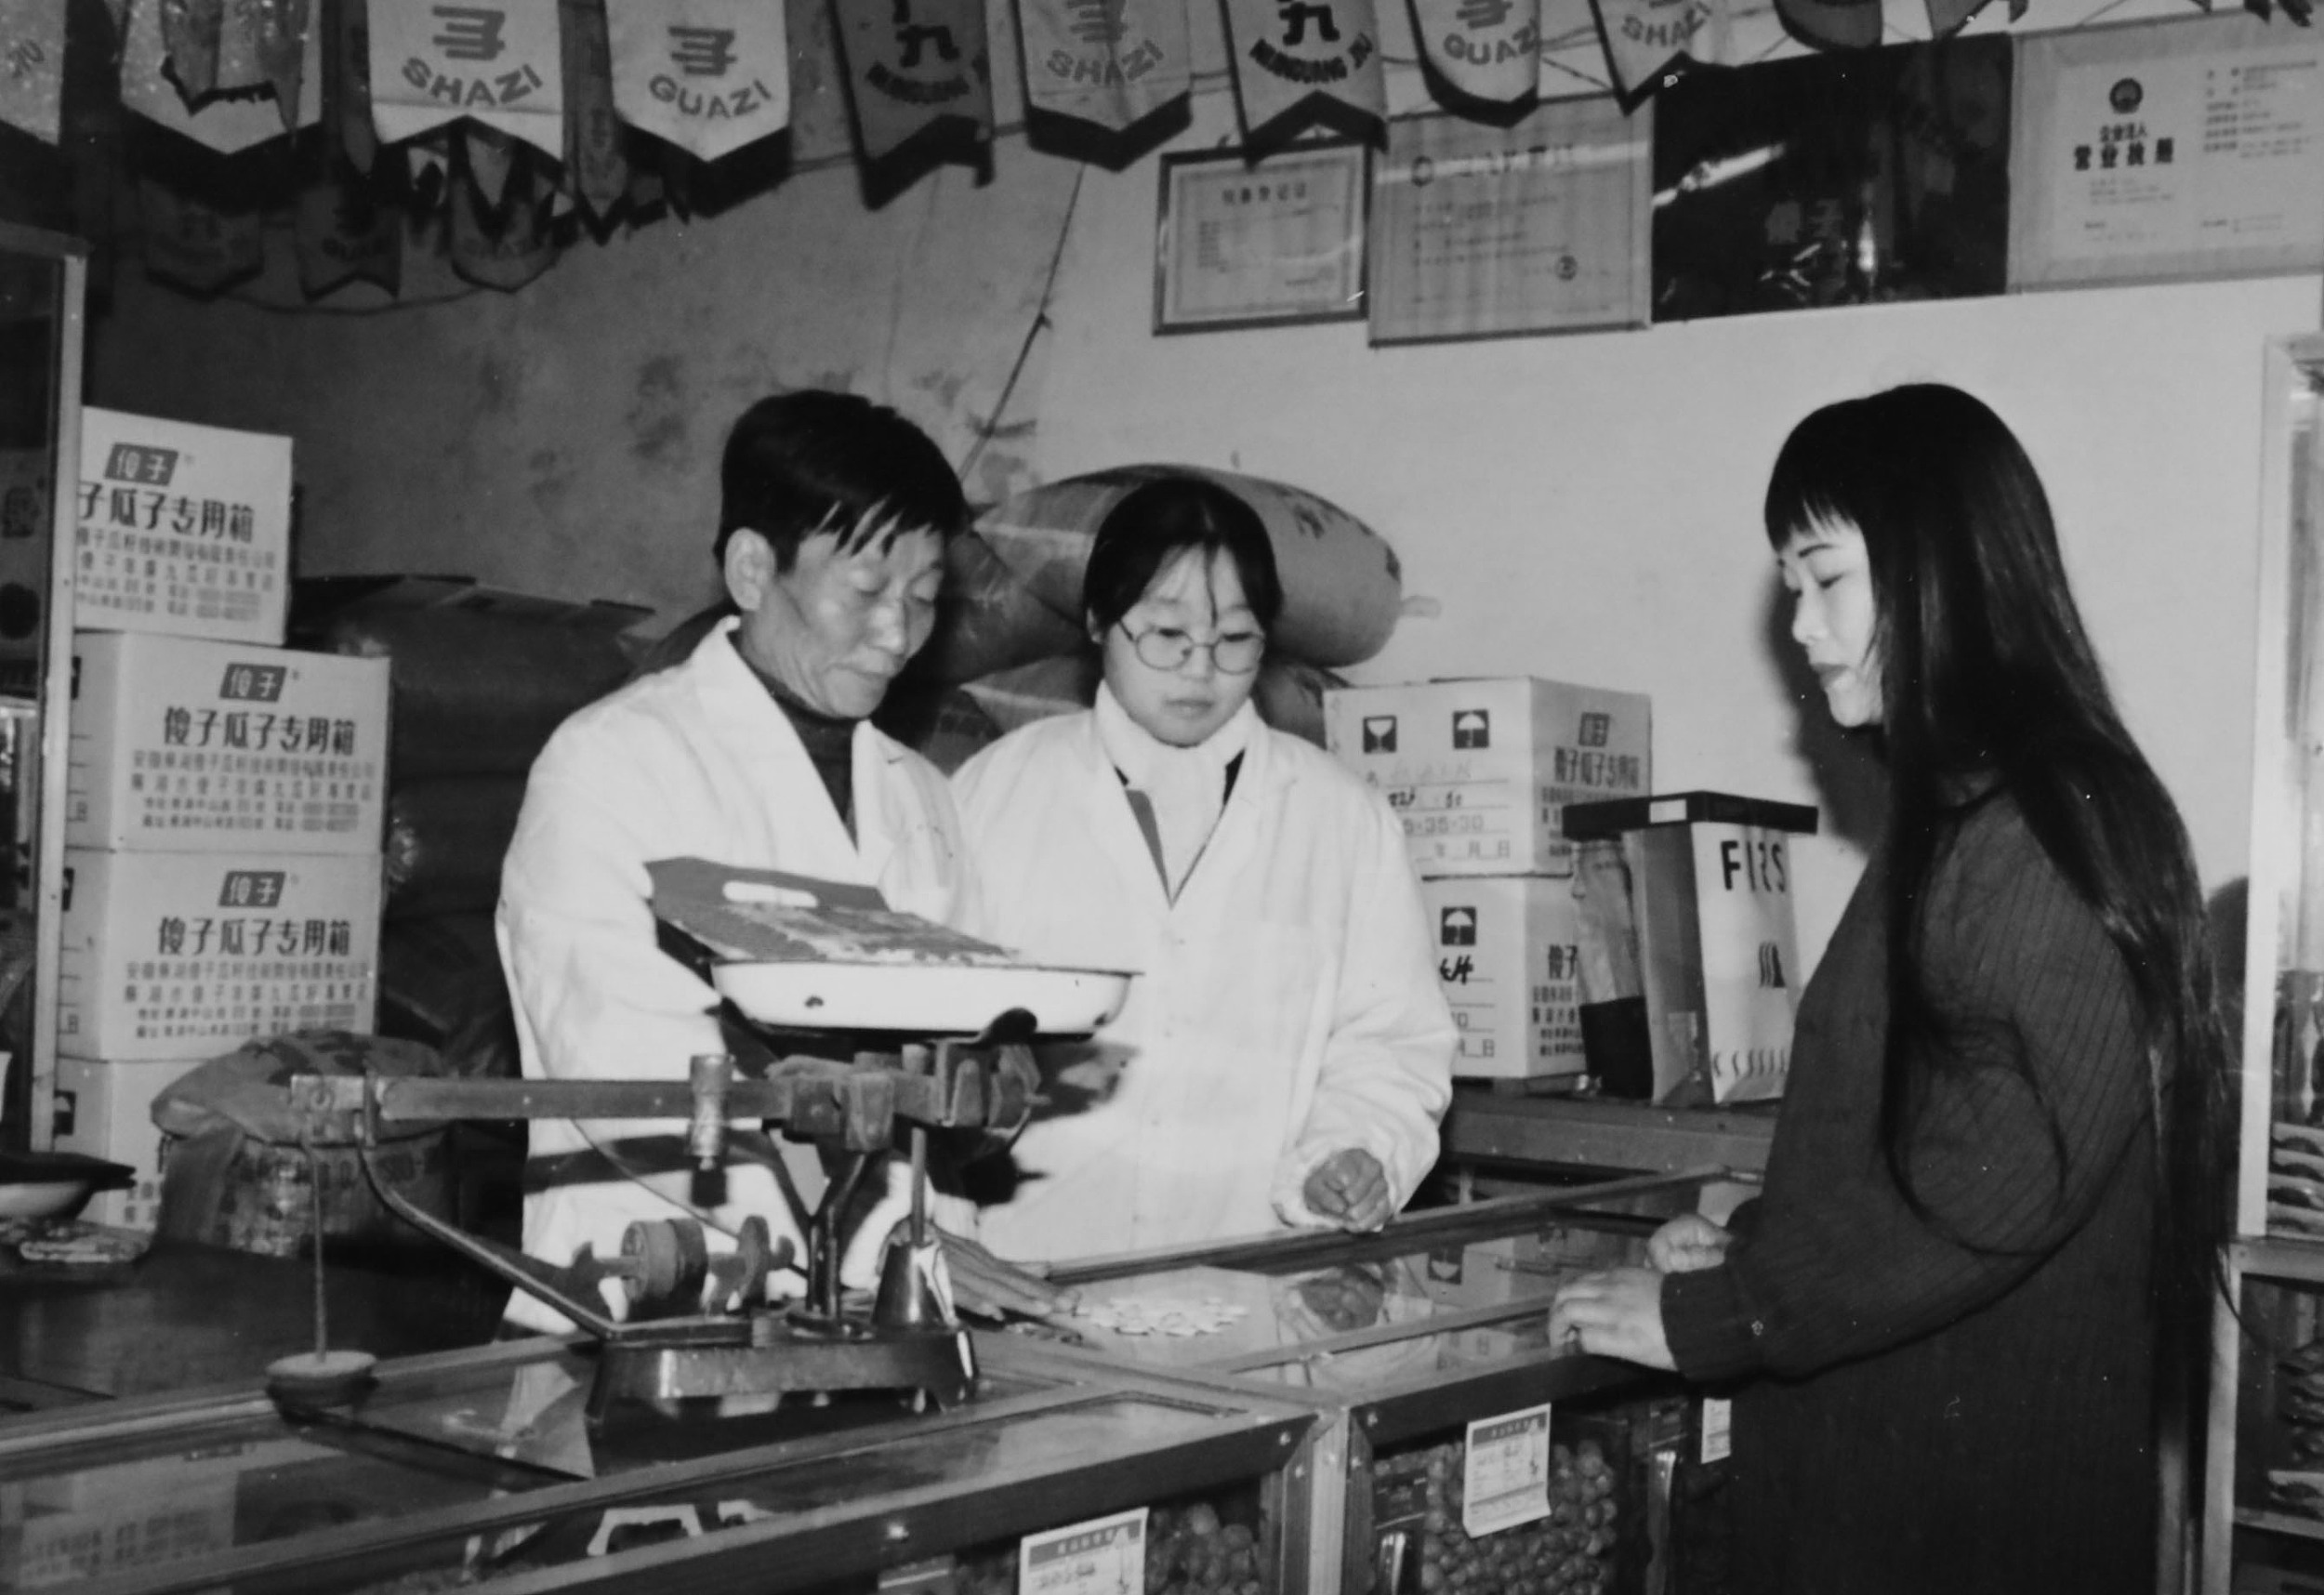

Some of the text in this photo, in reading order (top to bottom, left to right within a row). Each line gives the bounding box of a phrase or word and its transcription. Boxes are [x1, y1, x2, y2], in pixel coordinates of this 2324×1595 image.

[401, 58, 543, 107] SHAZI
[1047, 40, 1164, 86] SHAZI
[649, 74, 772, 119] GUAZI
